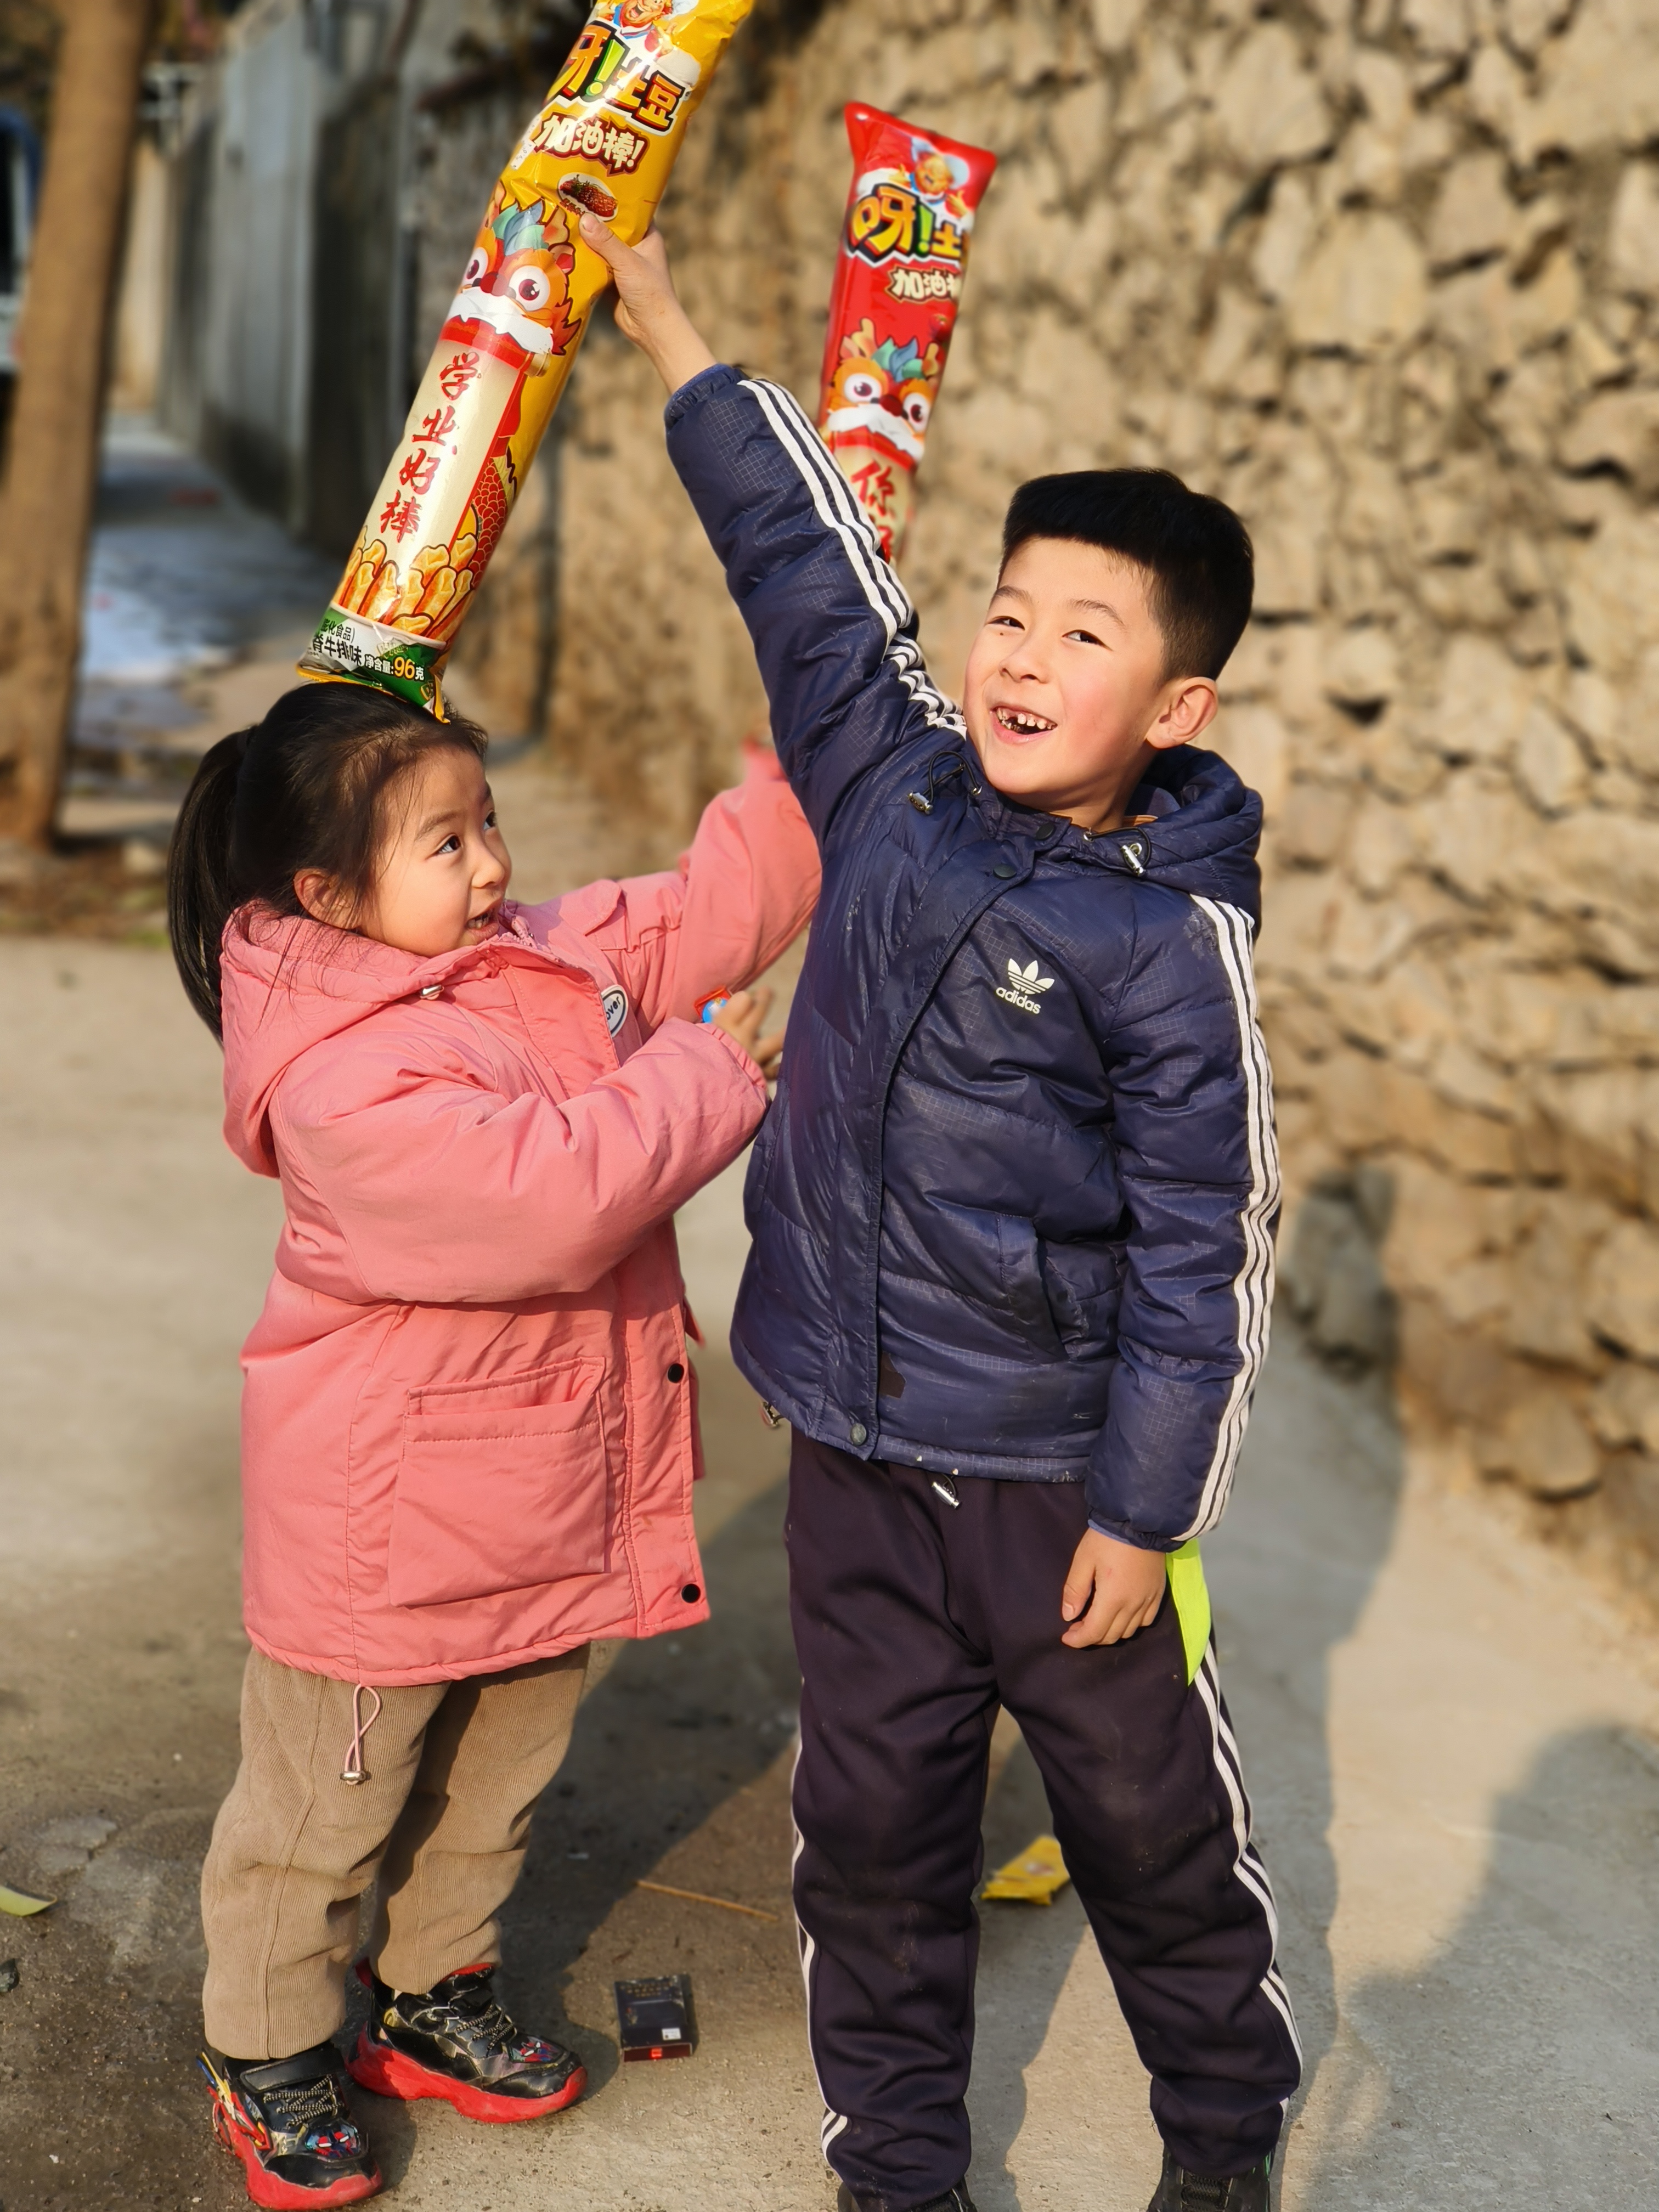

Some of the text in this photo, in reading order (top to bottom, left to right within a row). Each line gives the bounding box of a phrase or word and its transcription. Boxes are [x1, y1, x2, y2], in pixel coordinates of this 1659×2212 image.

[534, 114, 645, 169] 加油棒!
[380, 352, 481, 544] 学业好棒
[364, 654, 425, 681] 净含量:96克
[996, 987, 1041, 1014] adidas
